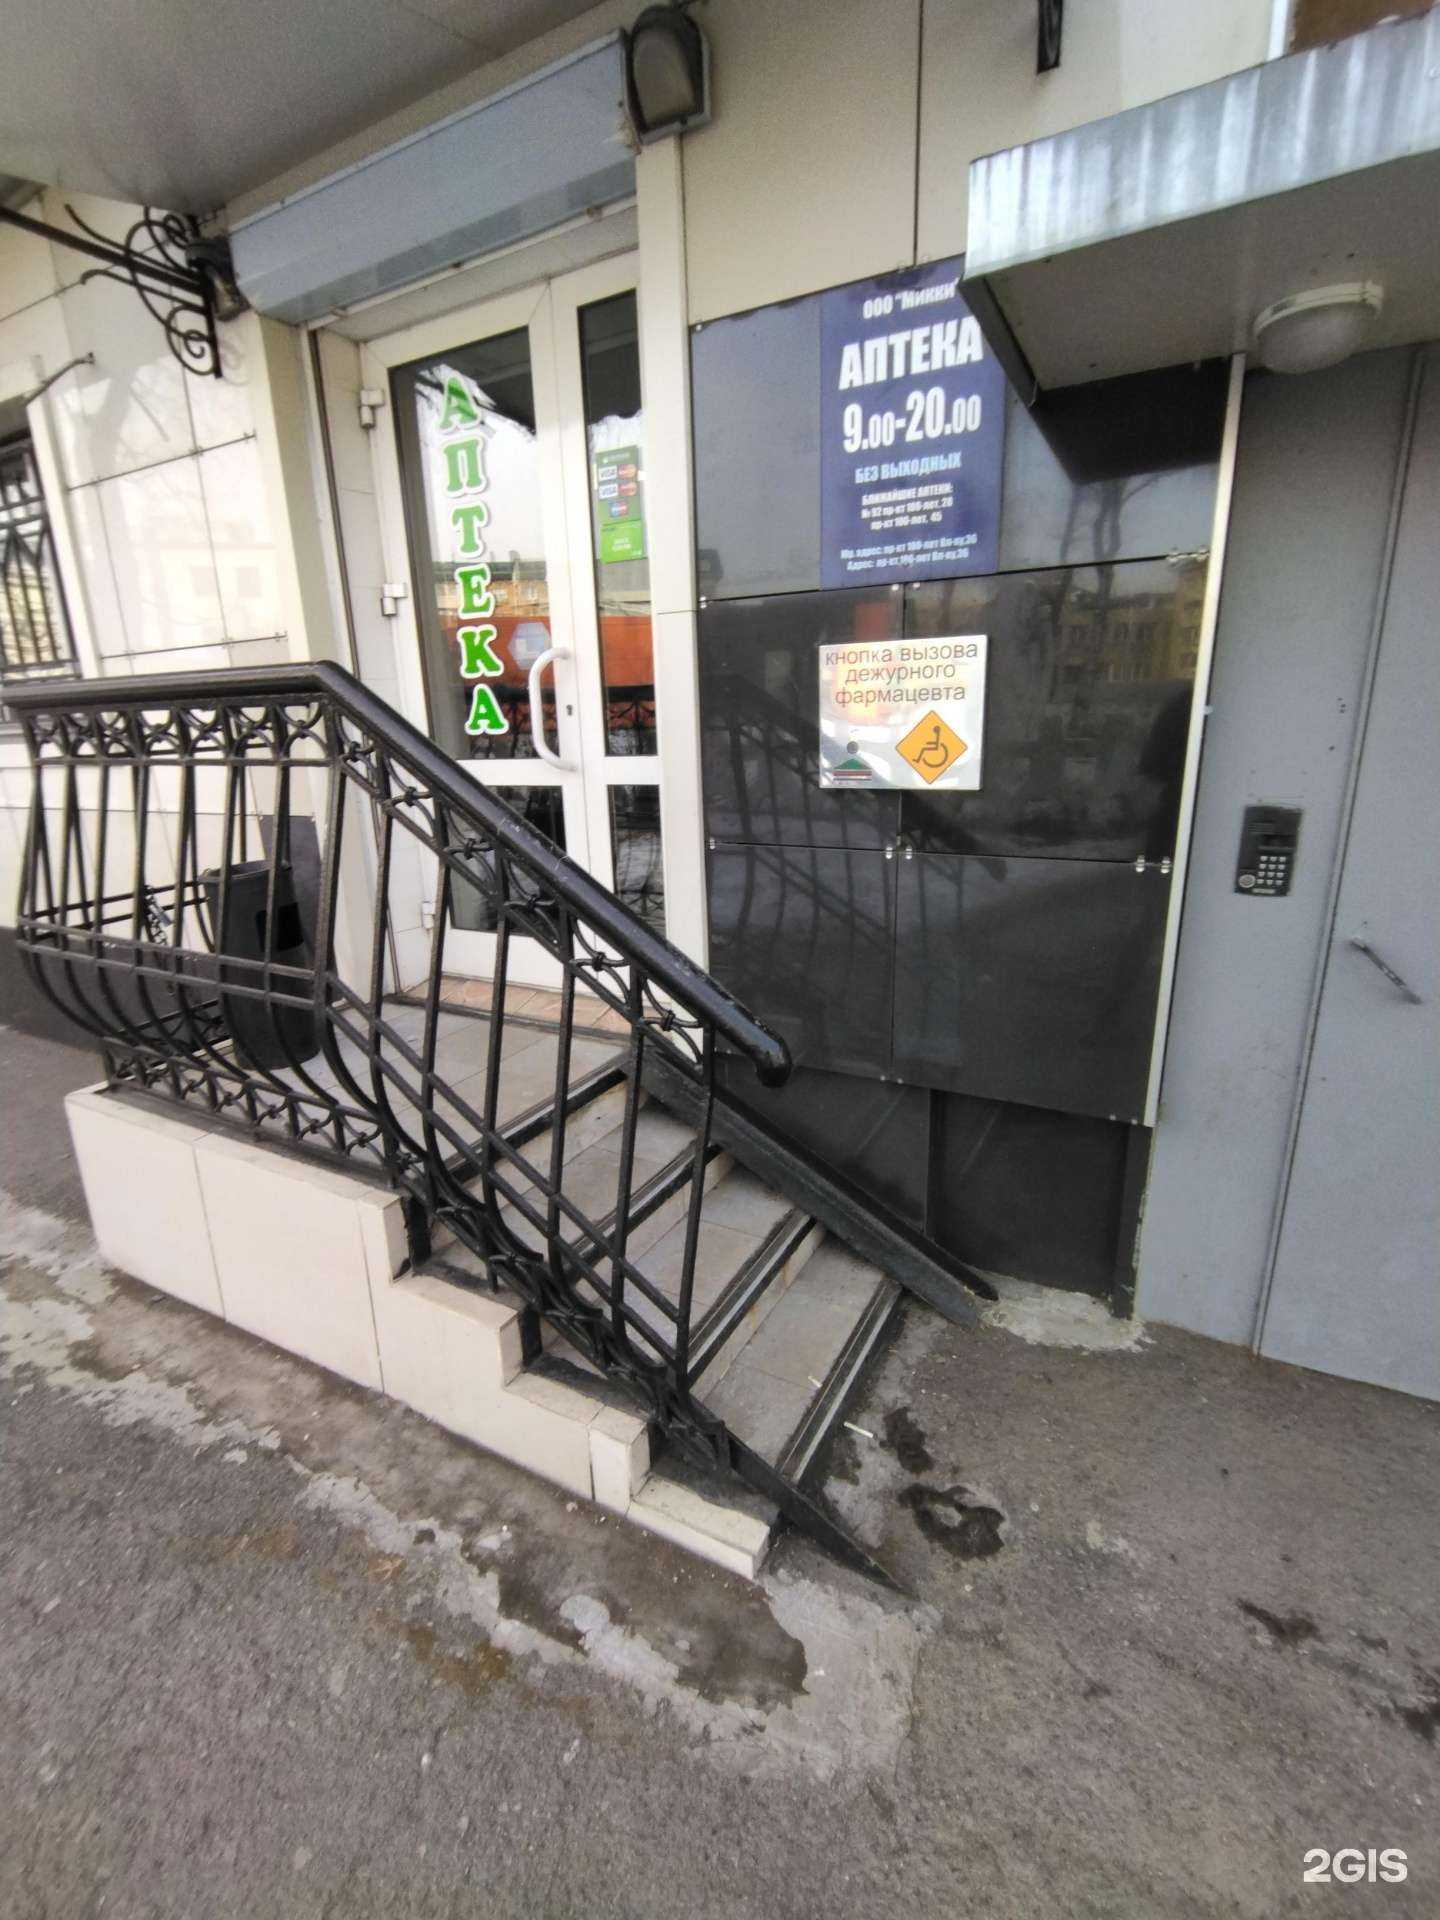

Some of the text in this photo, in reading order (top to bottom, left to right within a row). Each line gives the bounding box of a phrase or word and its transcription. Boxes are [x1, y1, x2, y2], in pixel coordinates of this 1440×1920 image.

[863, 294, 893, 319] ООО
[838, 315, 984, 390] АПТЕКА
[855, 452, 962, 484] БЕЗ ВЫХОДНЫХ
[439, 376, 507, 736] АПТЕКА
[825, 643, 978, 666] кнопка вызова
[845, 664, 956, 685] дежурного
[835, 686, 966, 708] фармацевта
